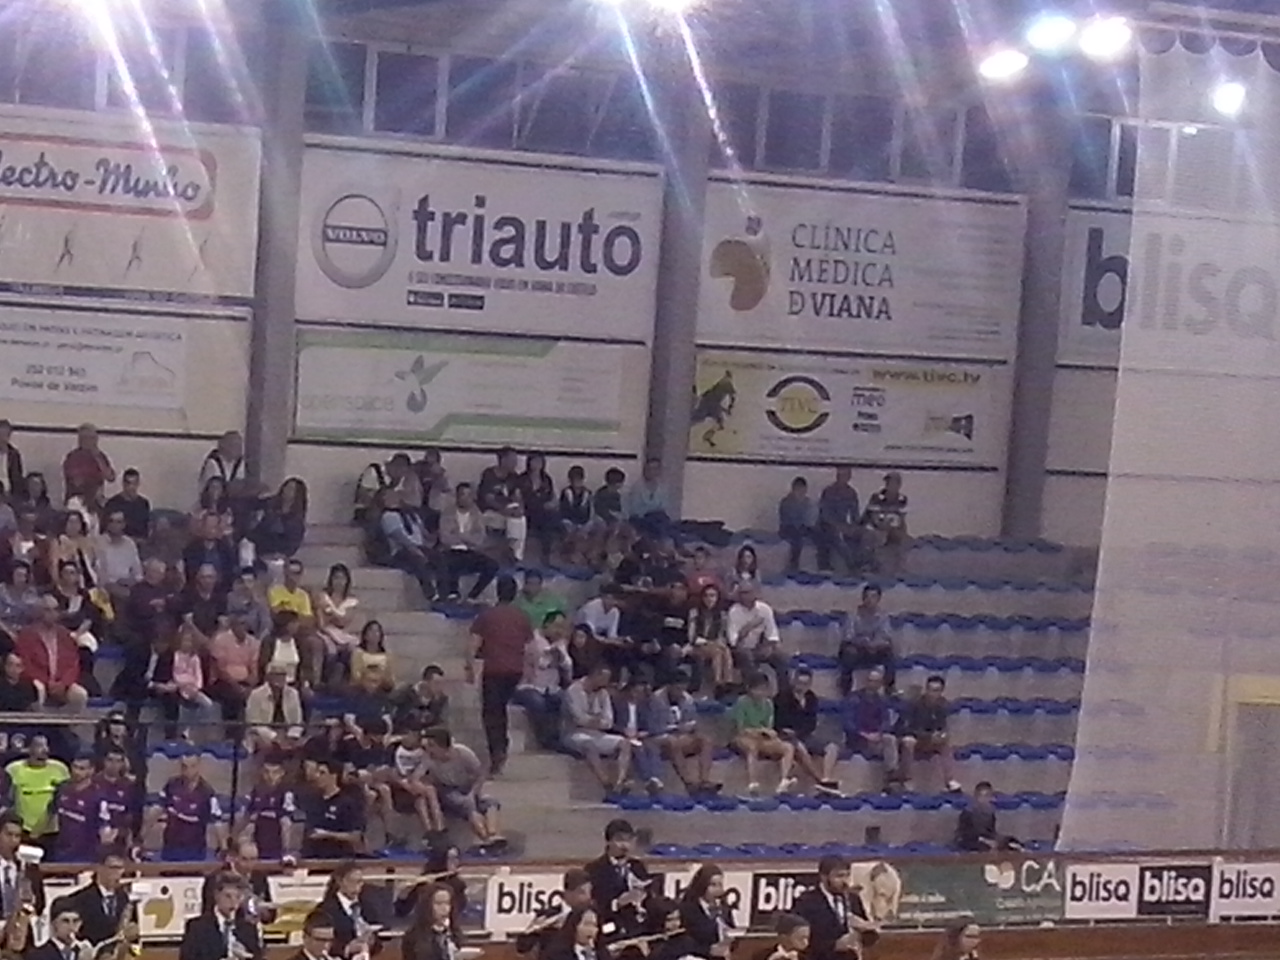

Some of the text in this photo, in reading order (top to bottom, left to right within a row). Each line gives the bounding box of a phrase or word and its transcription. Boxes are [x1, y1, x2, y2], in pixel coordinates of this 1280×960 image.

[326, 227, 386, 246] VOLVO
[412, 194, 643, 277] triauto
[791, 219, 897, 256] CLÍNICA
[811, 292, 893, 321] VIANA
[1022, 860, 1062, 892] CA
